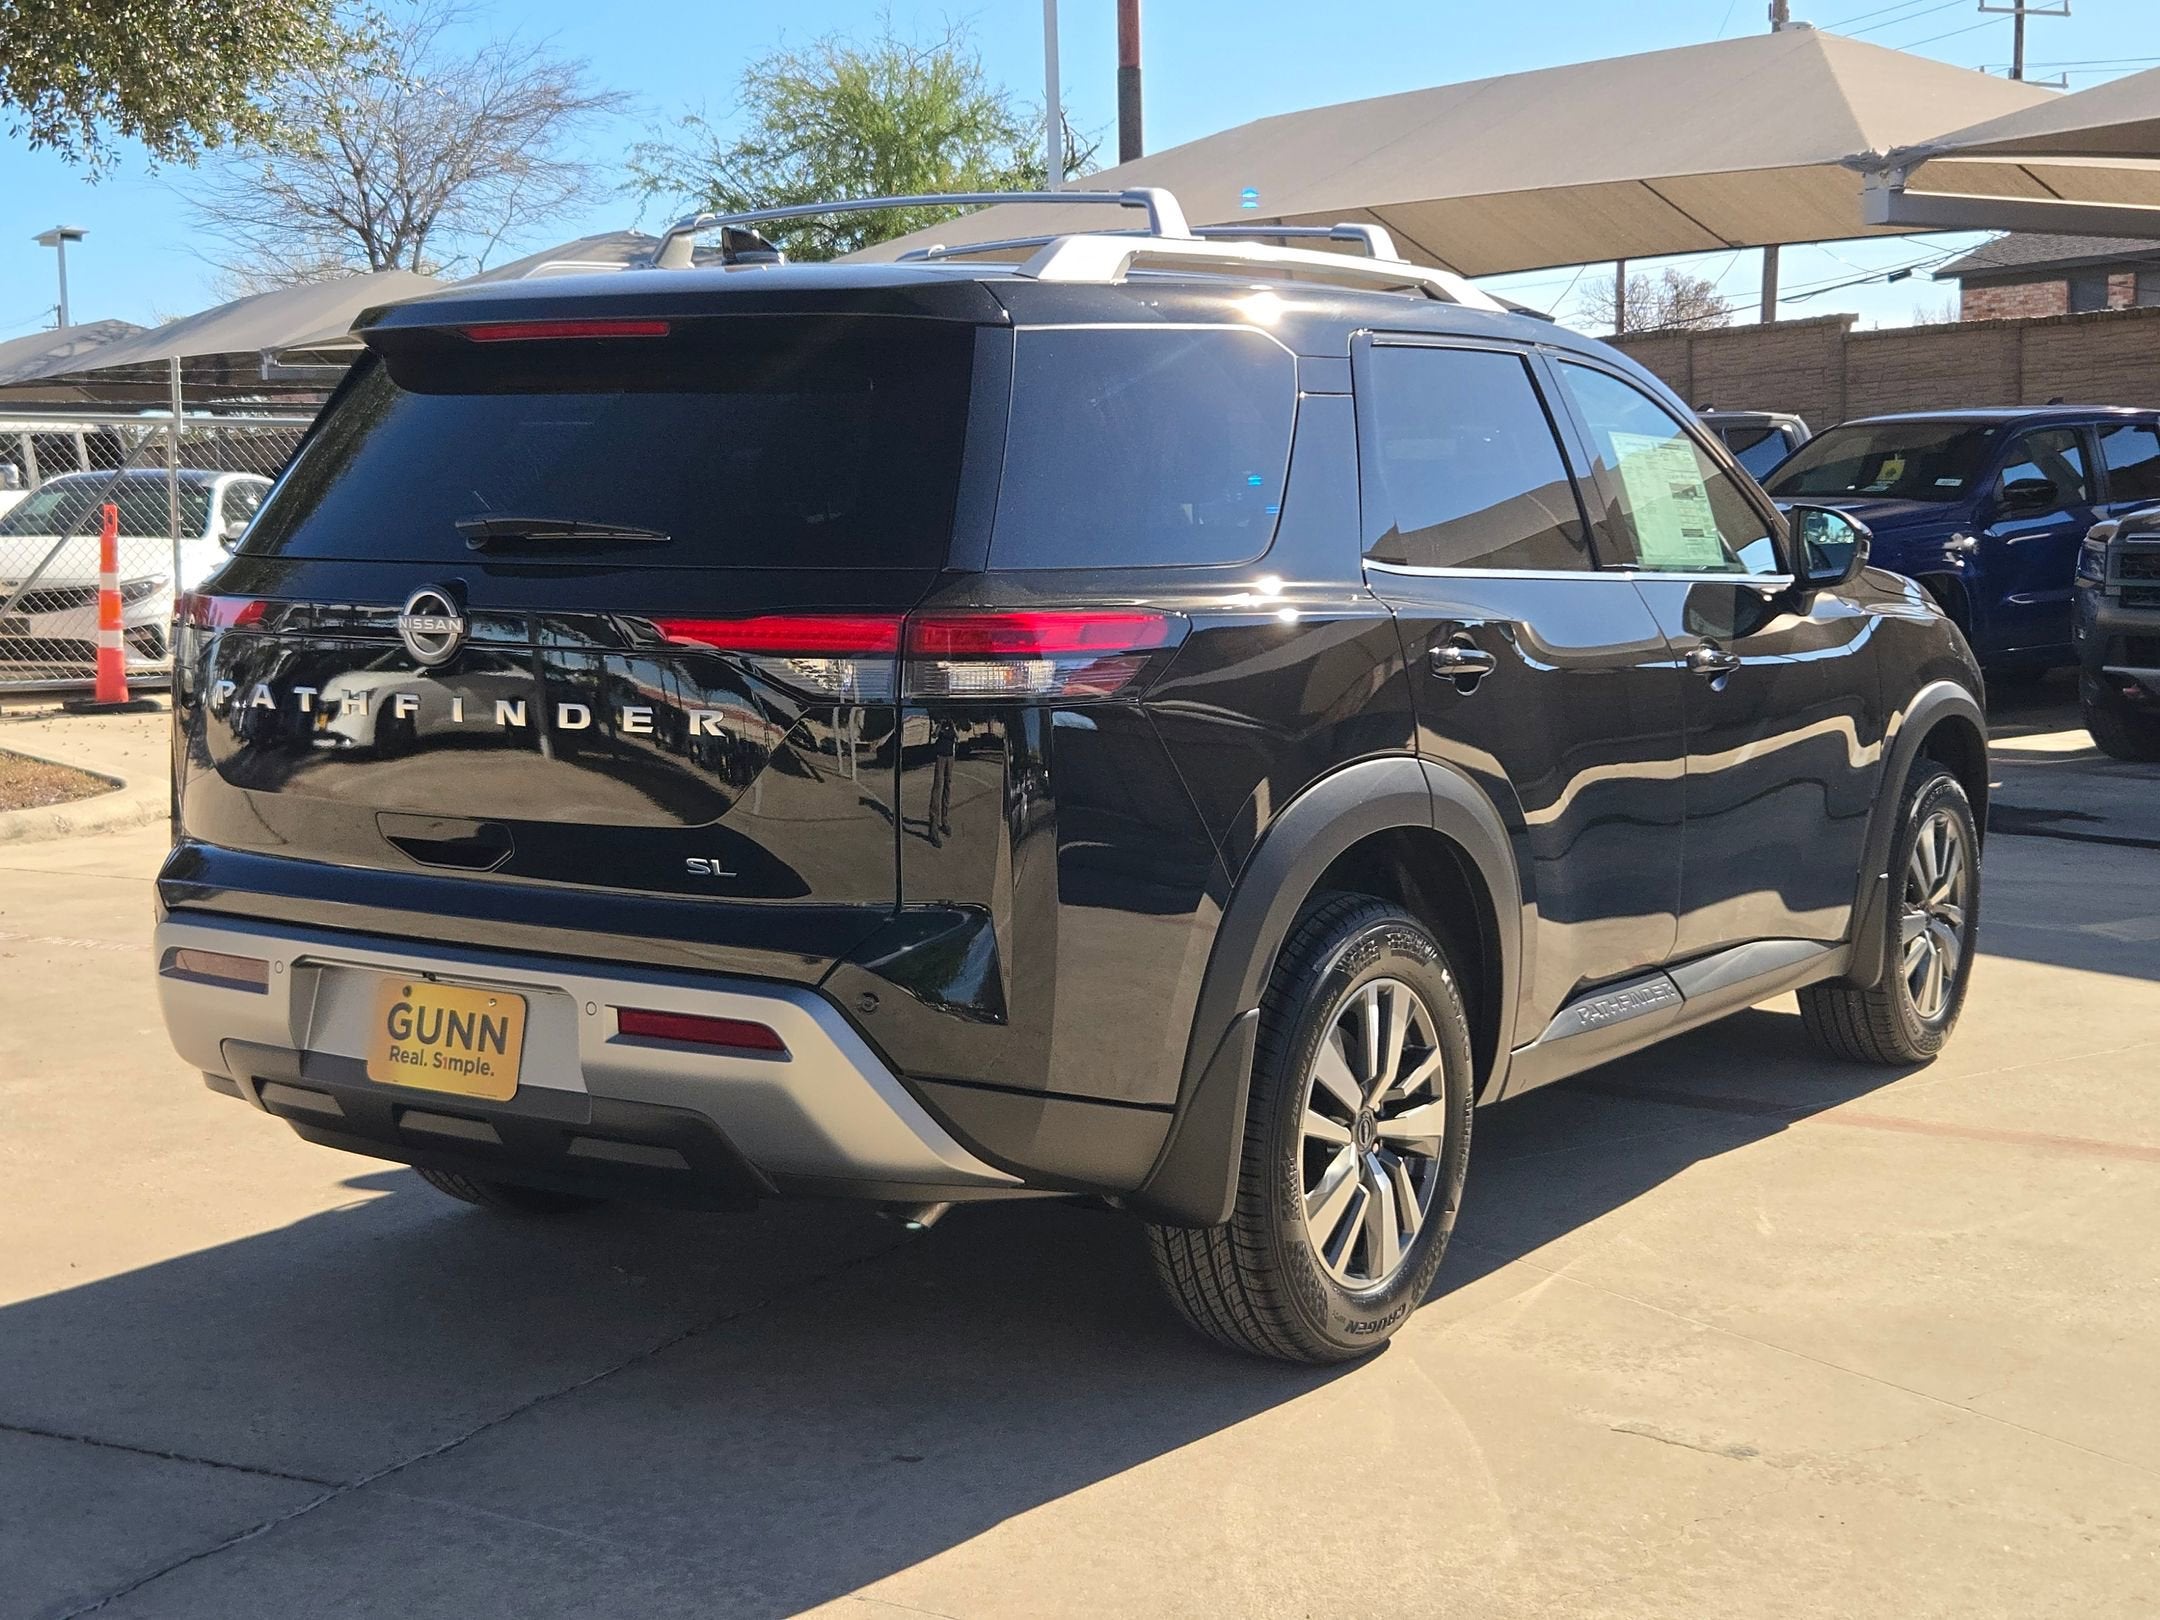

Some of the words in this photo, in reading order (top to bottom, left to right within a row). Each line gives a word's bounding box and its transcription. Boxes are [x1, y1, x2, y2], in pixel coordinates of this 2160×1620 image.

[400, 618, 461, 631] NISSAN
[214, 679, 726, 738] PATHFINDER
[686, 858, 737, 877] SL
[1576, 983, 1676, 1025] PATHFINDER
[387, 1002, 509, 1055] GUNN
[389, 1045, 427, 1067] Real.
[1344, 1302, 1406, 1335] CRUGEN
